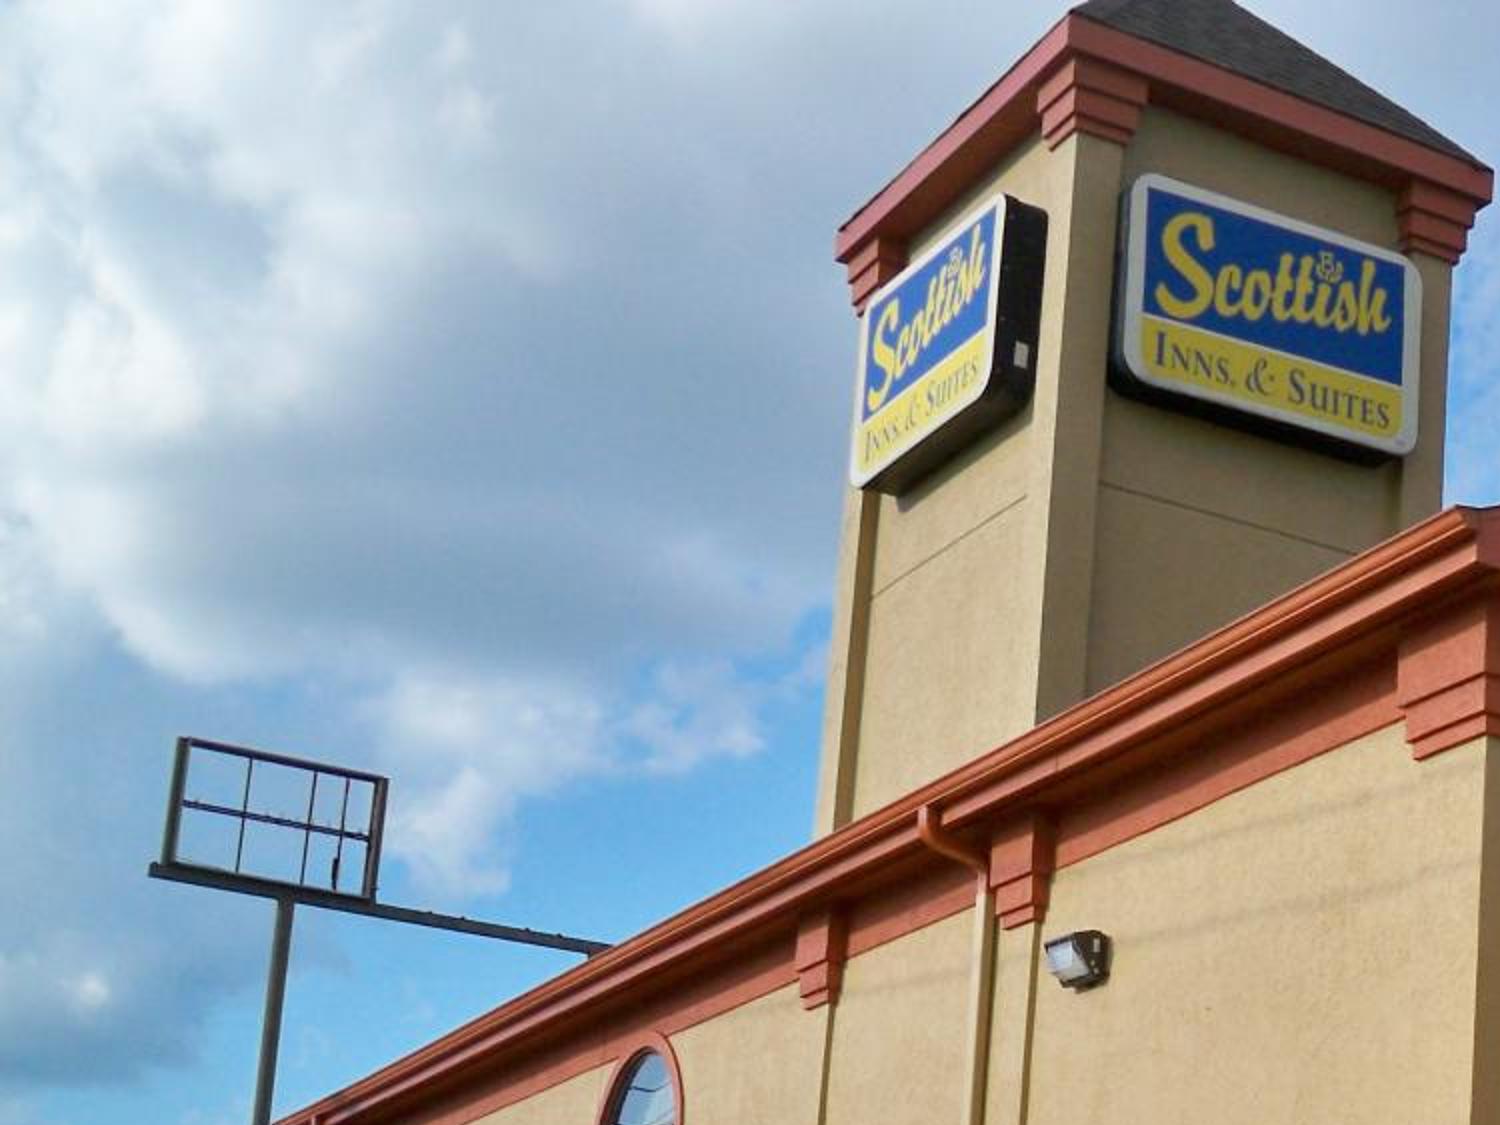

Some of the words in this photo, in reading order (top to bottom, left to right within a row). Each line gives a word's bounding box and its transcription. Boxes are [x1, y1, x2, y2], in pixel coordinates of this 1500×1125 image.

[866, 223, 987, 412] Scottish
[1154, 211, 1392, 336] Scottish
[925, 354, 979, 418] SUITES
[1244, 356, 1276, 397] &
[1287, 368, 1391, 430] SUITES
